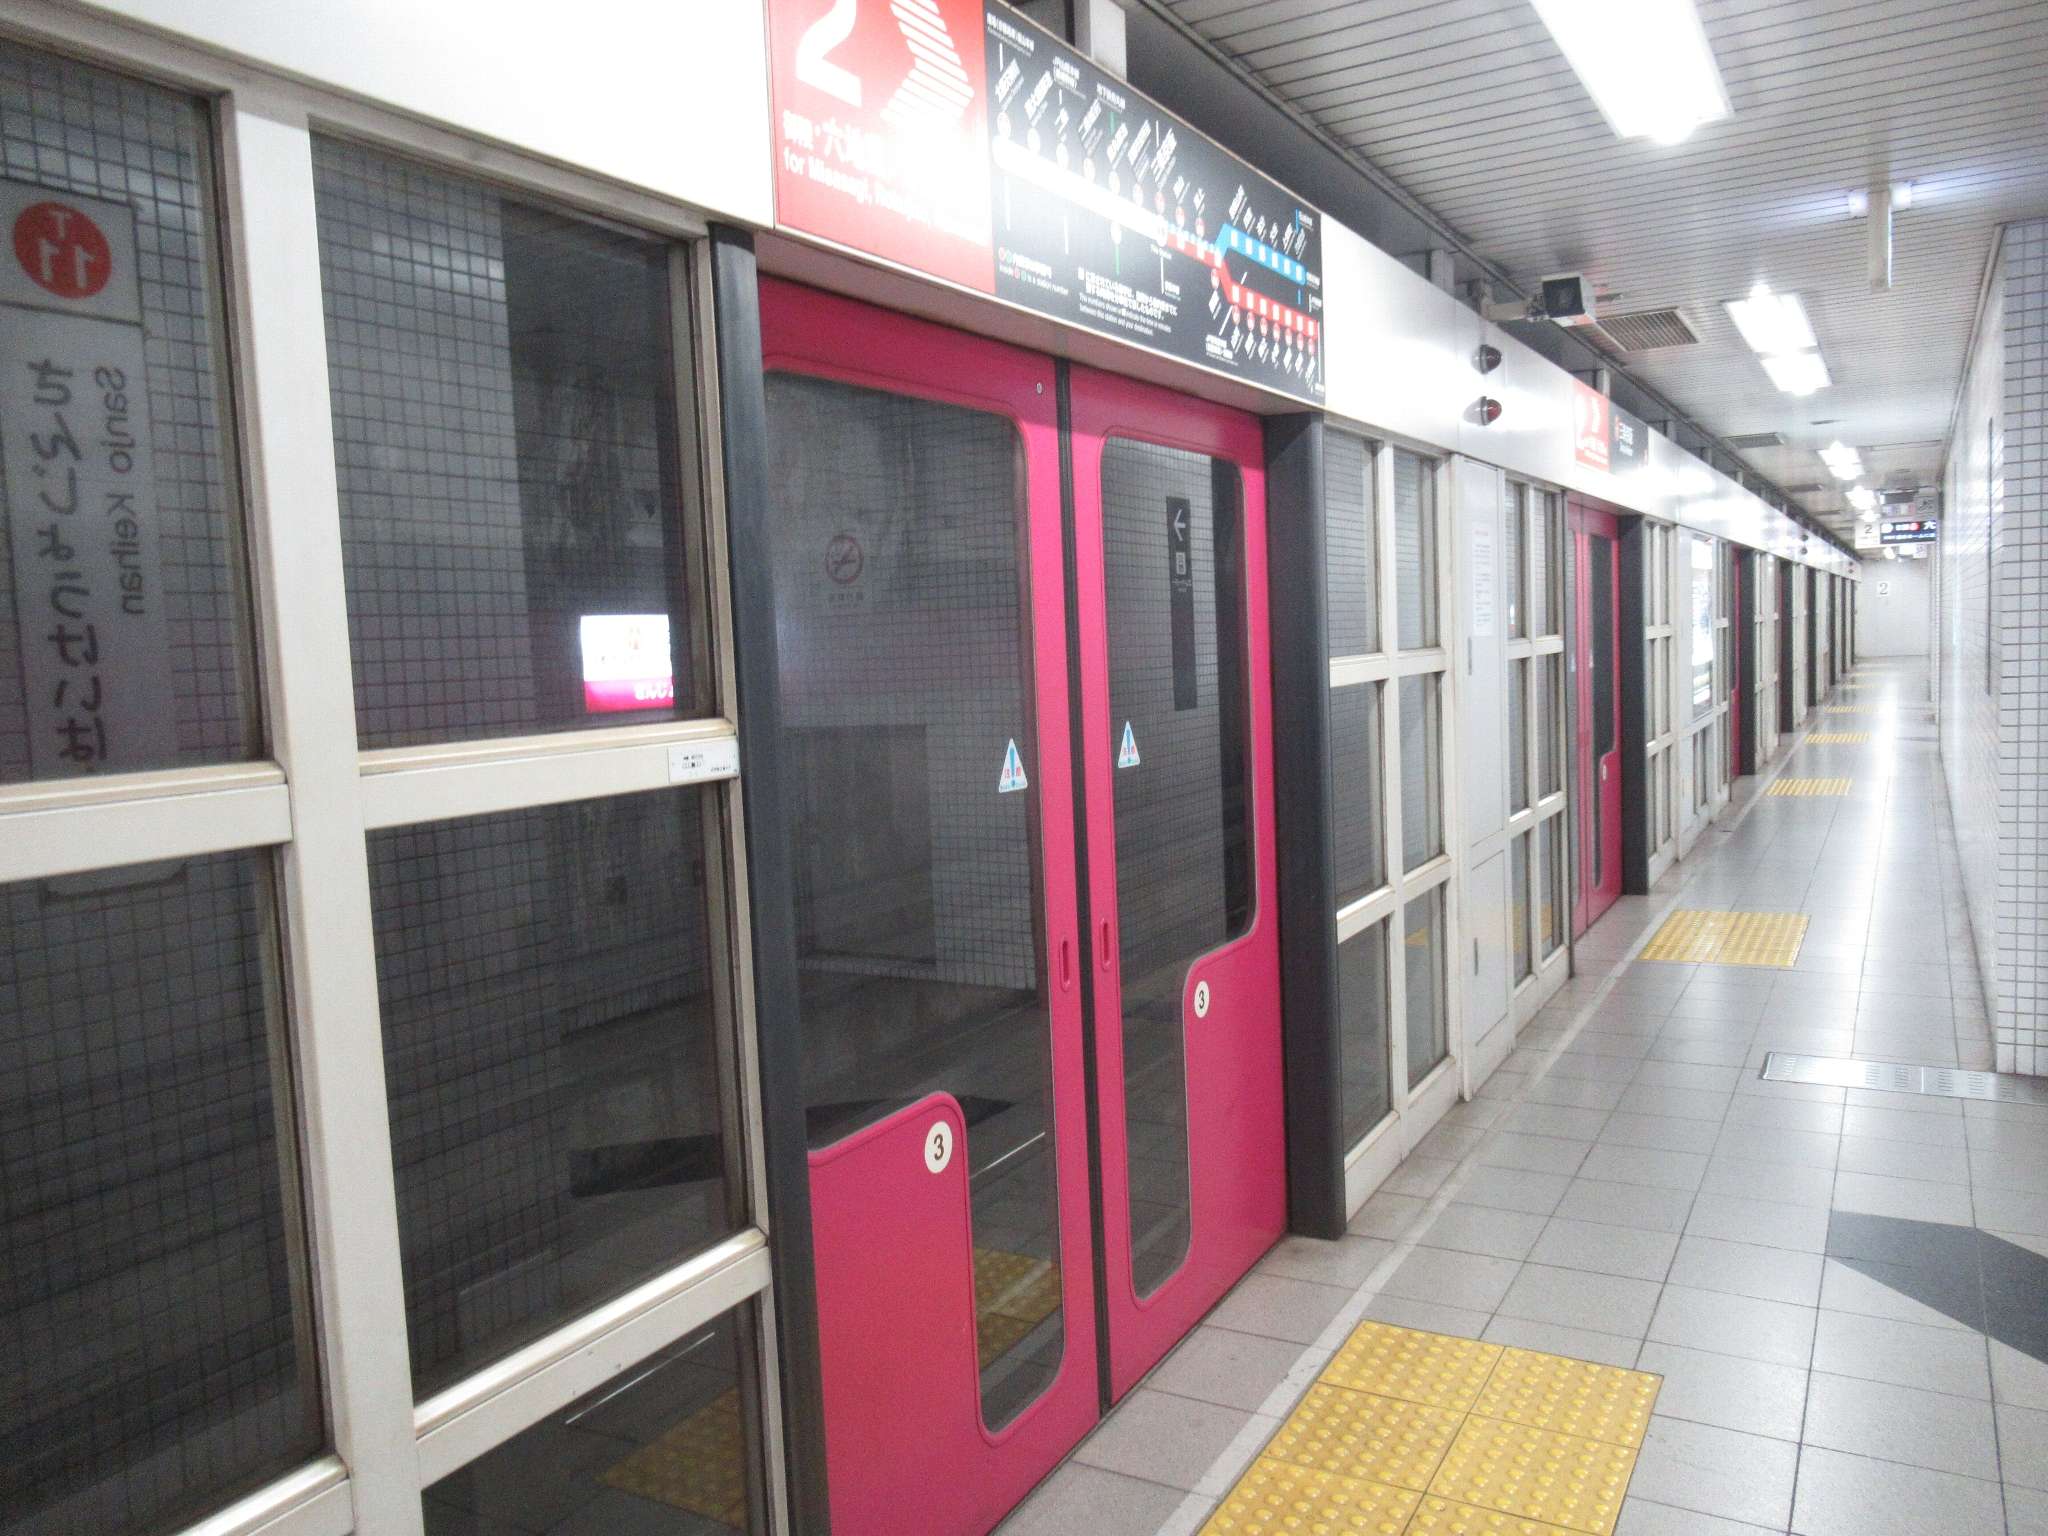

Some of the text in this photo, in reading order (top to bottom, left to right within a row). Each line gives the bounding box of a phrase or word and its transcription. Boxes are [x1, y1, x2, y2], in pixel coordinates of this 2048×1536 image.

[795, 0, 862, 107] 2
[1879, 583, 1889, 595] 2
[1198, 990, 1206, 1009] 3
[933, 1133, 945, 1161] 3
